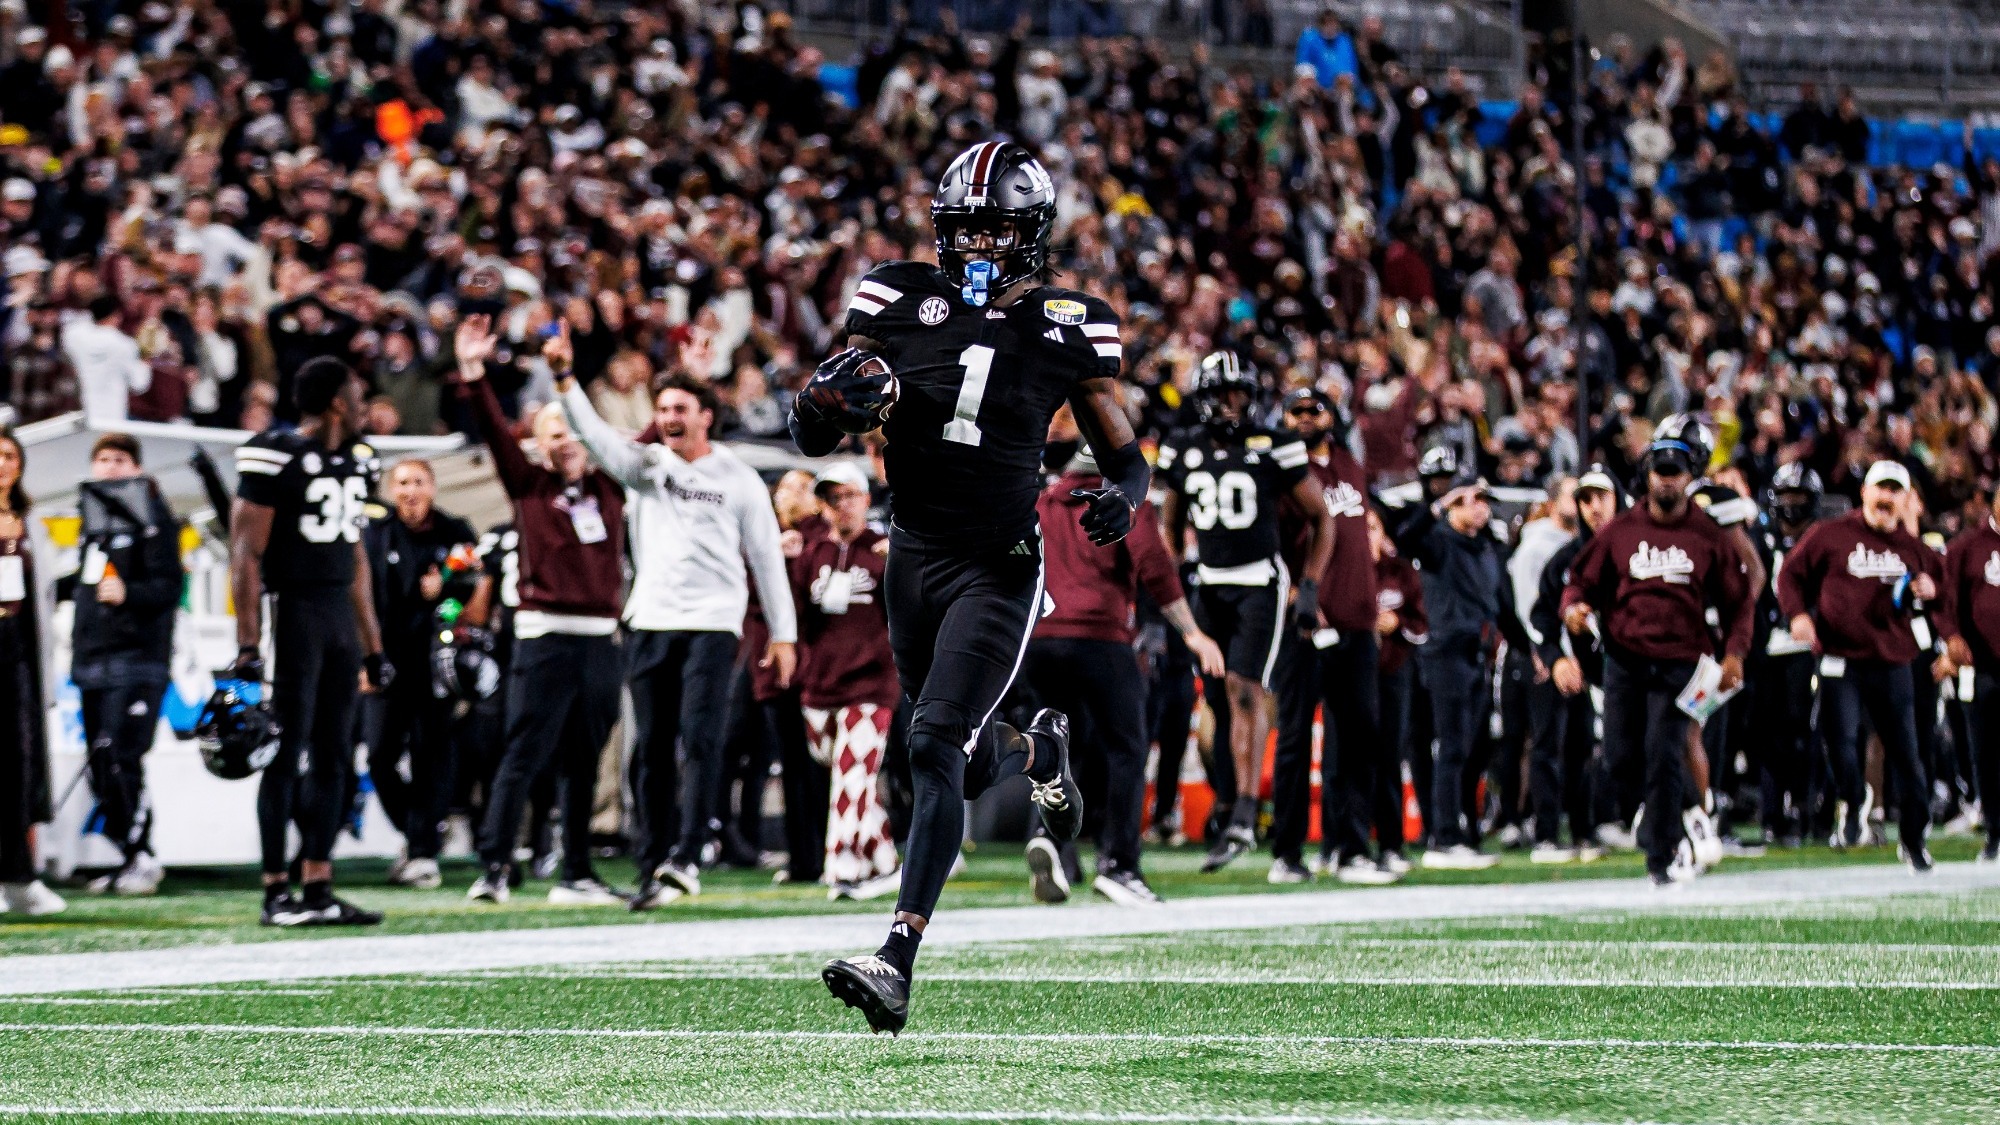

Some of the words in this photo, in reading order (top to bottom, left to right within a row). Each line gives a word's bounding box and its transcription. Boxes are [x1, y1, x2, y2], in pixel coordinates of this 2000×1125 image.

[921, 300, 948, 323] SEC
[1054, 312, 1076, 323] BOWL
[942, 344, 995, 447] 1
[1185, 471, 1258, 530] 30
[1629, 541, 1694, 580] State
[1848, 542, 1907, 579] State
